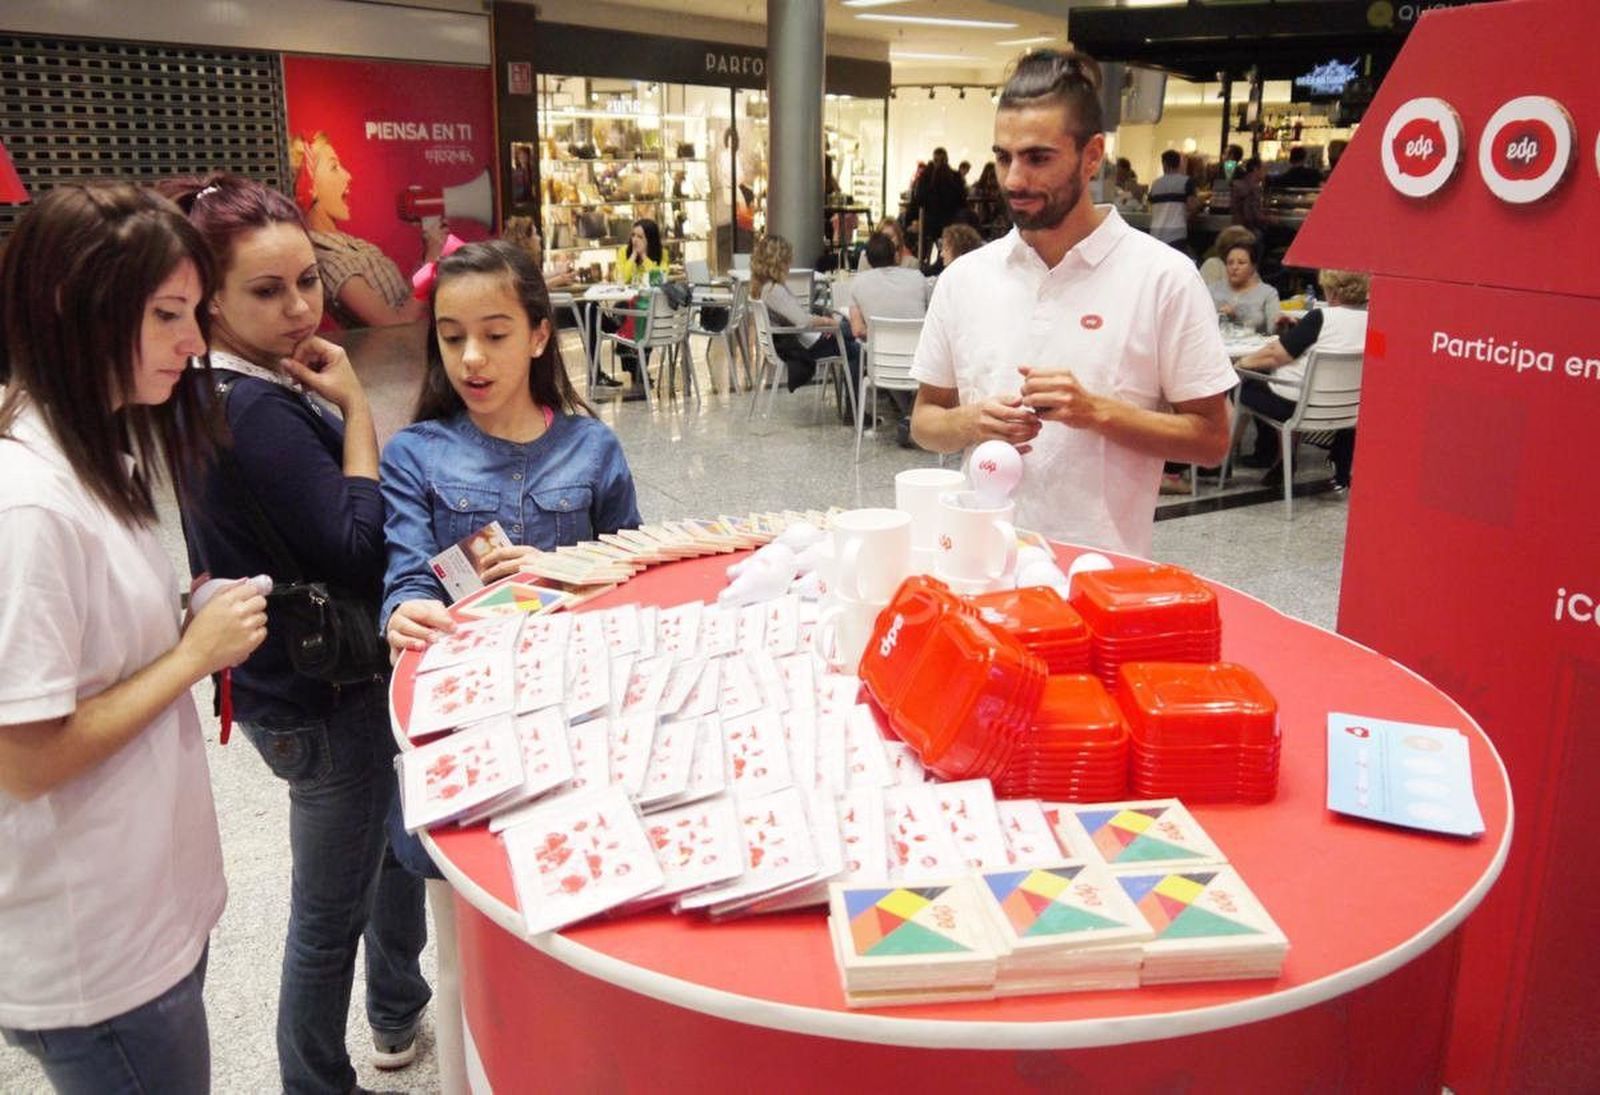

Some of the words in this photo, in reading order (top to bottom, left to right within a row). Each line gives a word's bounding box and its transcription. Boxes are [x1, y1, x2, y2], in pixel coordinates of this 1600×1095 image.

[705, 53, 768, 76] PARFO
[365, 121, 429, 140] PIENSA
[432, 123, 454, 140] EN
[456, 123, 472, 140] TI
[1405, 134, 1434, 160] edp
[1506, 136, 1538, 164] edp
[1432, 331, 1554, 373] Participa
[1565, 356, 1600, 380] en
[881, 613, 904, 657] edp
